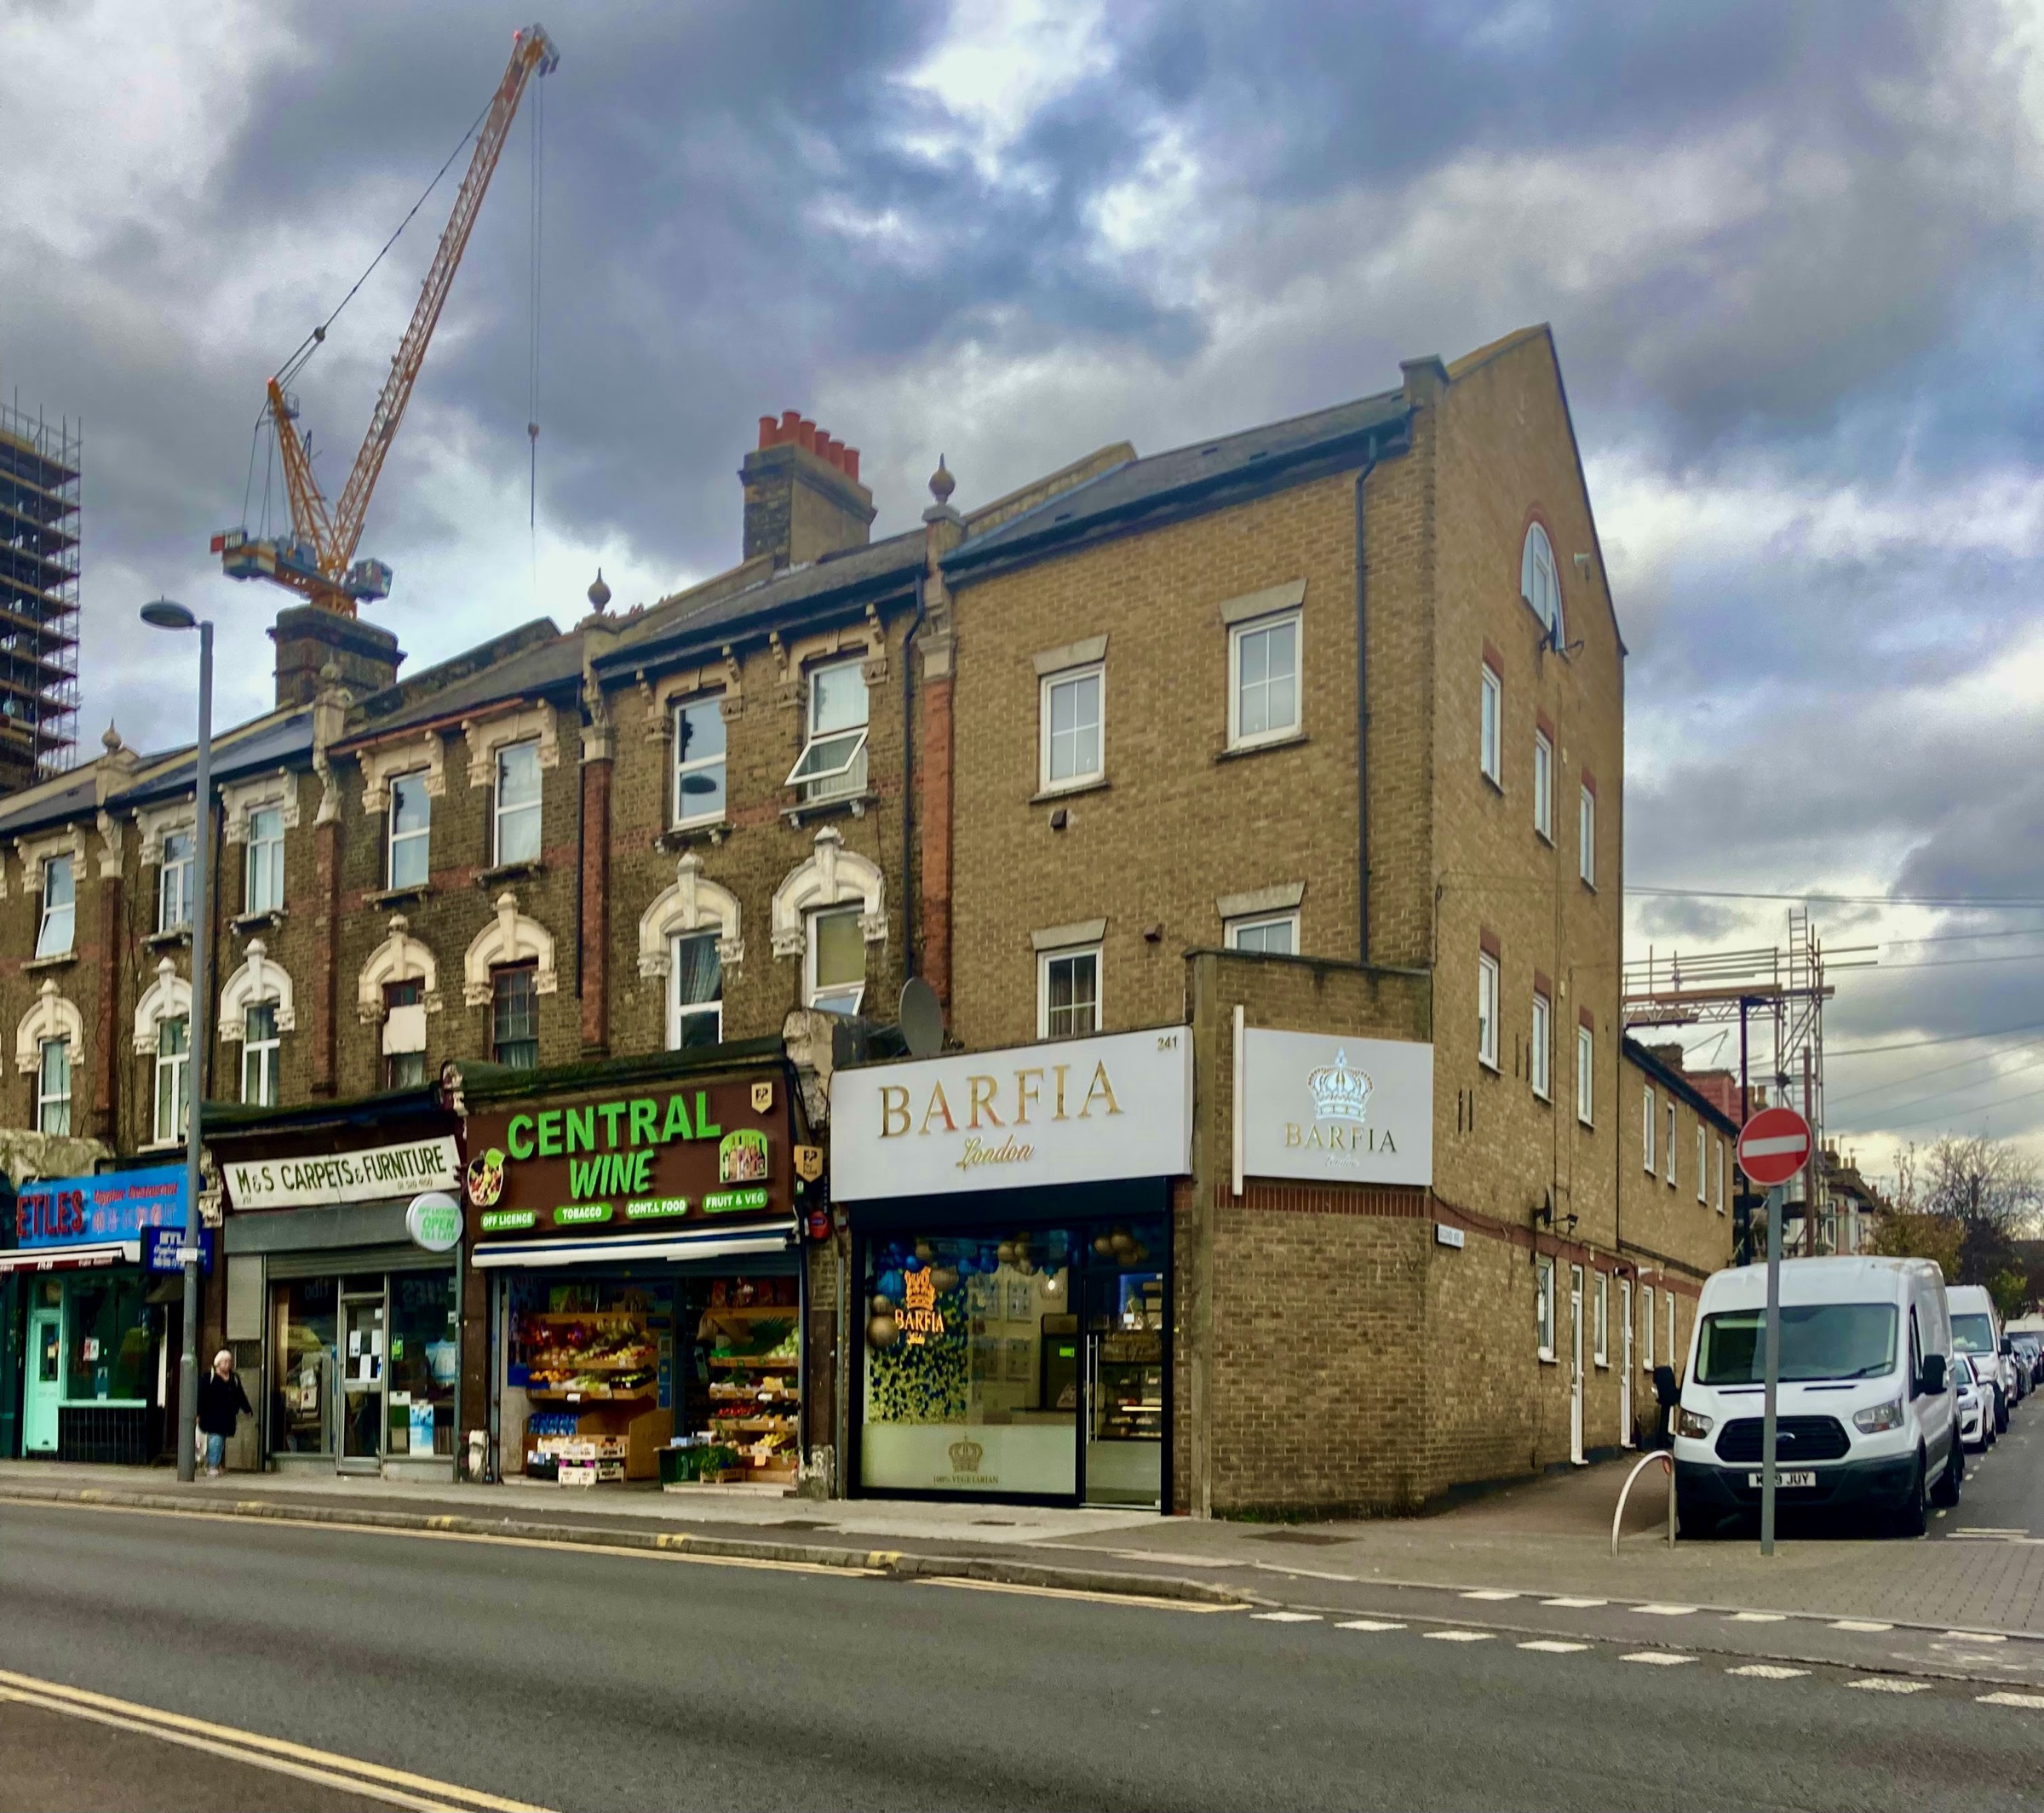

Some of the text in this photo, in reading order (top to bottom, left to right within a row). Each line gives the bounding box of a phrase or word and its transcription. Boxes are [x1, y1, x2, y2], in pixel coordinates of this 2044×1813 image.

[1157, 1036, 1178, 1051] 241
[878, 1059, 1123, 1138] BARFIA
[508, 1091, 721, 1160] CENTRAL
[1285, 1122, 1398, 1153] BARFIA
[956, 1134, 1036, 1171] London
[281, 1158, 353, 1190] CARPETS
[364, 1145, 447, 1180] FURNITURE
[570, 1149, 654, 1200] WINE
[662, 1199, 686, 1213] FOOD
[705, 1190, 765, 1208] FRUIT & VEG
[16, 1189, 83, 1237] ETLES
[422, 1216, 456, 1231] OPEN
[482, 1212, 533, 1228] OFF LICENCE
[562, 1206, 602, 1220] TOBACCO
[895, 1309, 944, 1333] BARFIA
[952, 1475, 999, 1484] VEGETARIAN
[1786, 1472, 1809, 1485] JUY
